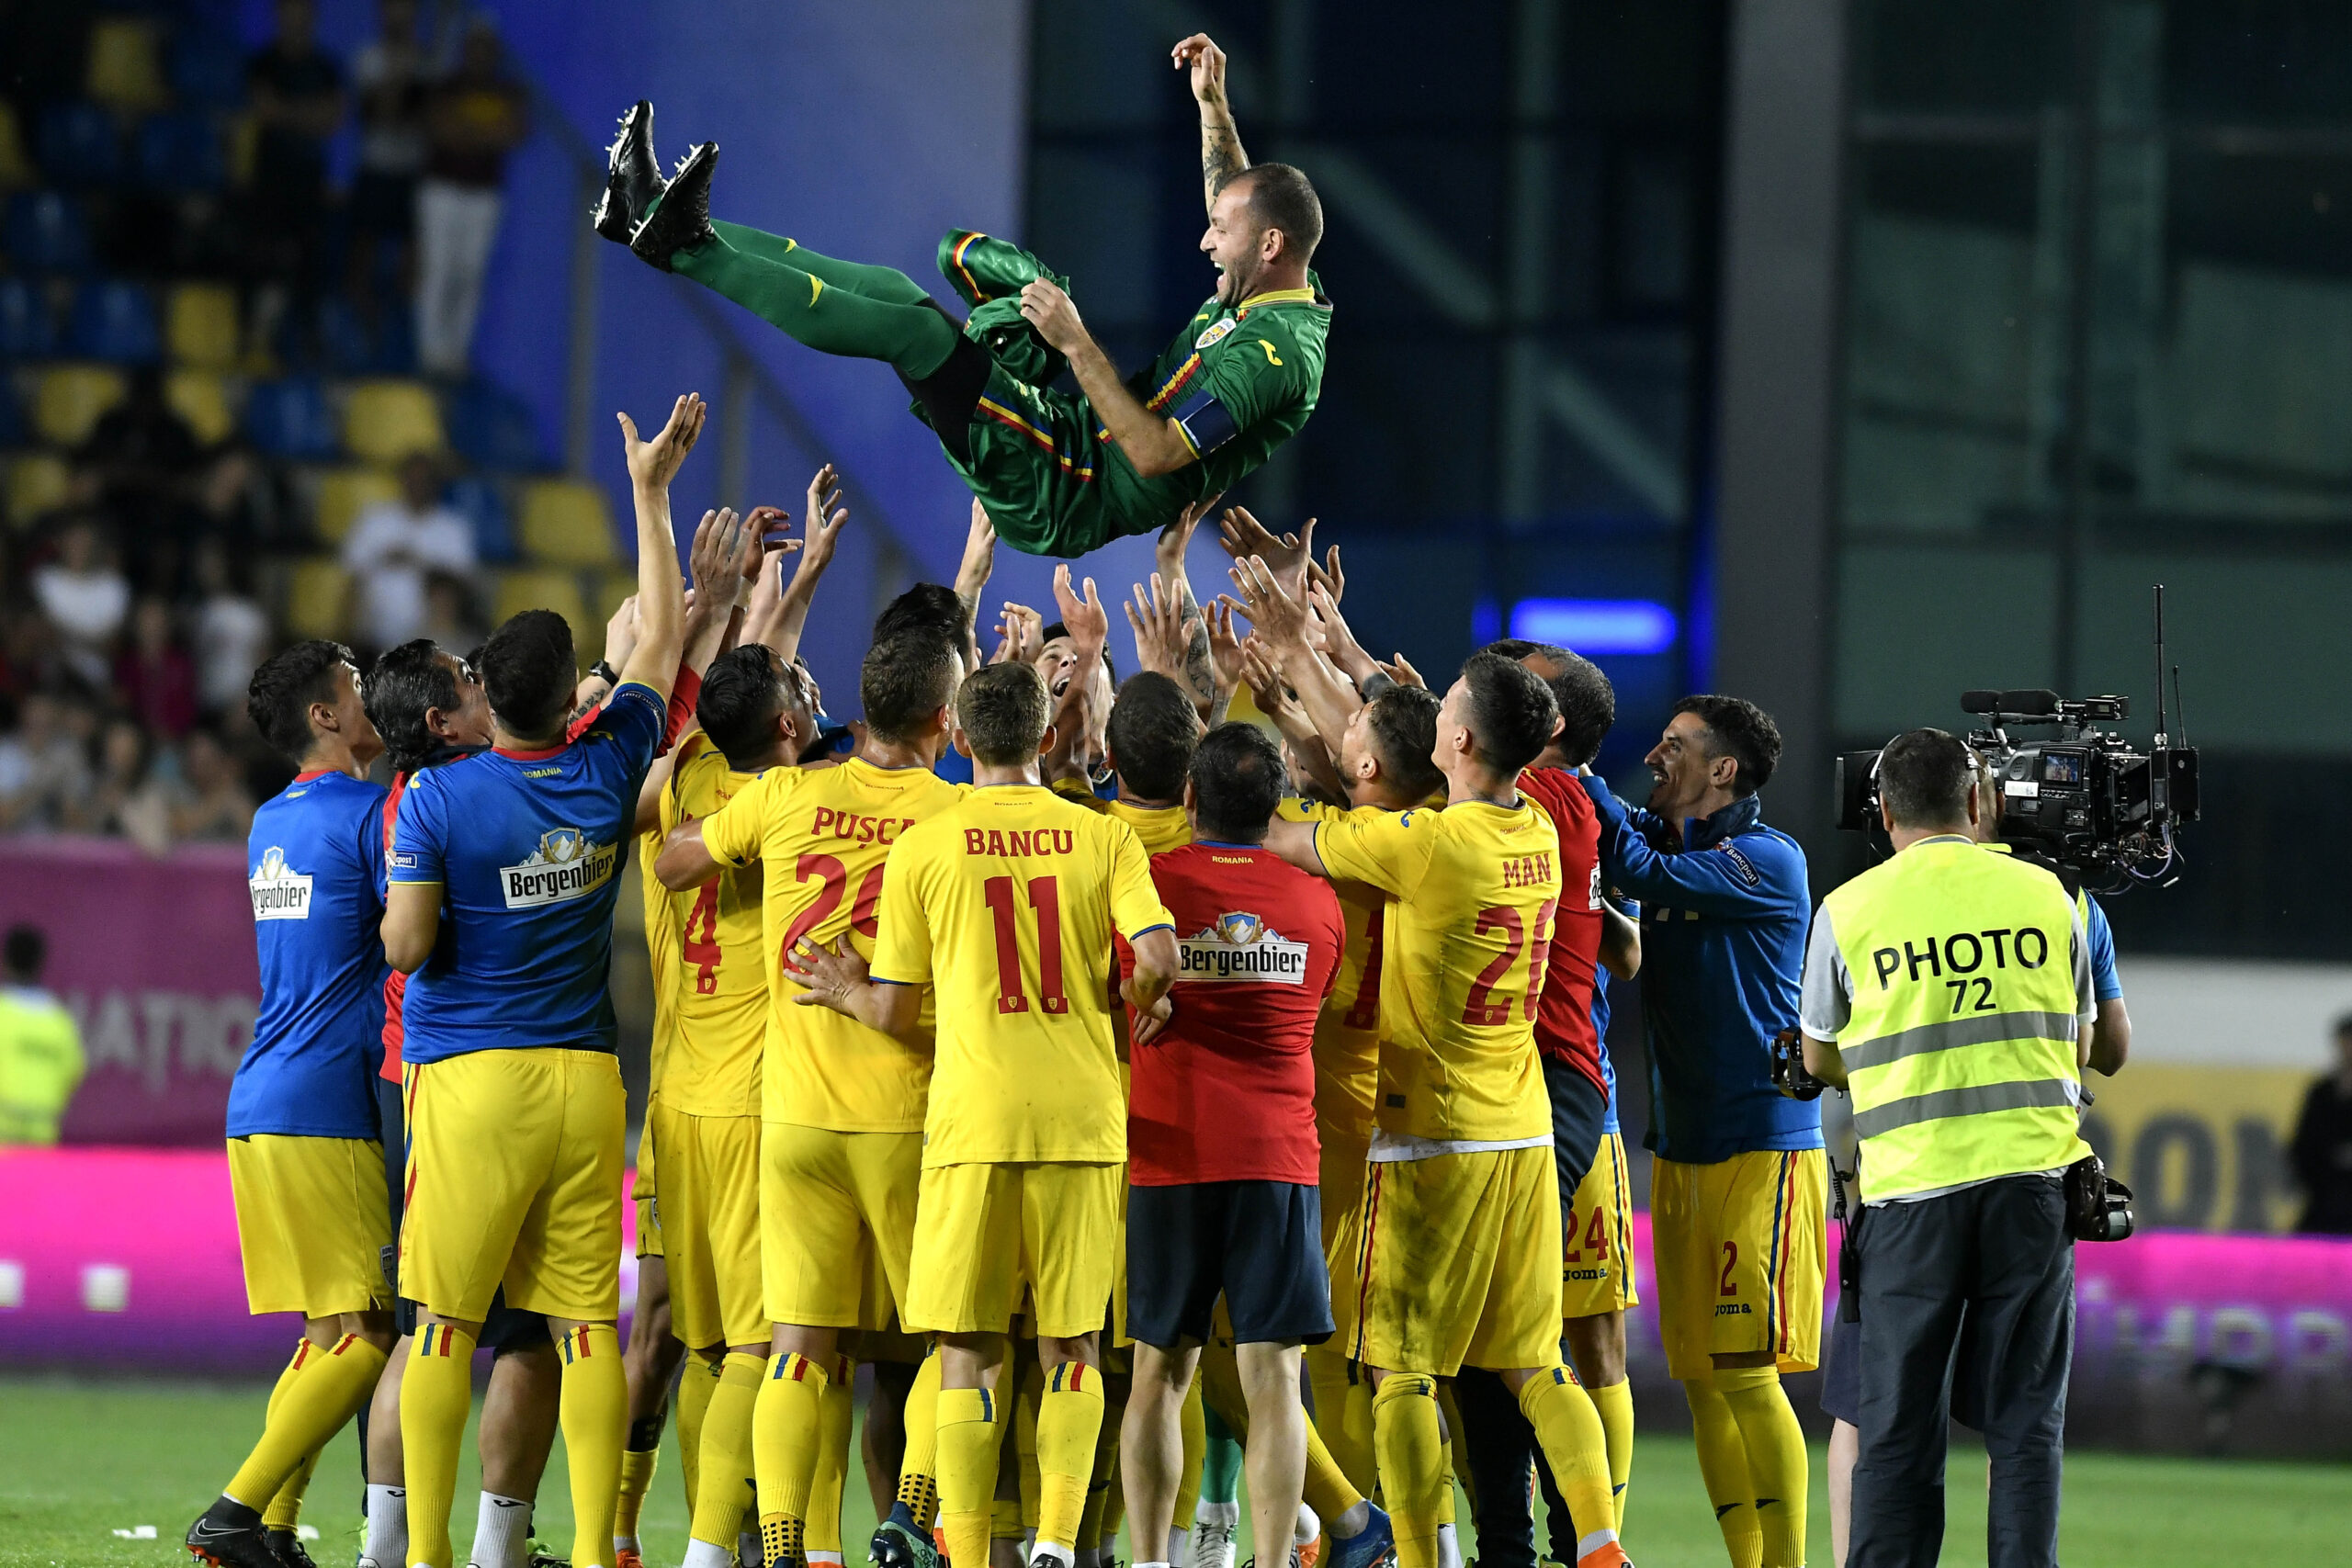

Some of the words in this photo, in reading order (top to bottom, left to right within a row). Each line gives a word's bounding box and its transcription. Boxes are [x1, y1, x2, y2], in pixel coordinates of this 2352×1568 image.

[965, 829, 1073, 857] BANCU
[1212, 855, 1253, 864] ROMANIA
[509, 853, 613, 898] Bergenbier
[1502, 852, 1551, 888] MAN
[1727, 849, 1757, 883] Bancpost
[252, 880, 307, 914] rgenbier
[984, 875, 1069, 1014] 11
[1181, 944, 1302, 976] Bergenbier
[1873, 927, 2048, 991] PHOTO
[1946, 976, 1996, 1013] 72
[1565, 1205, 1609, 1262] 24
[1720, 1240, 1737, 1296] 2
